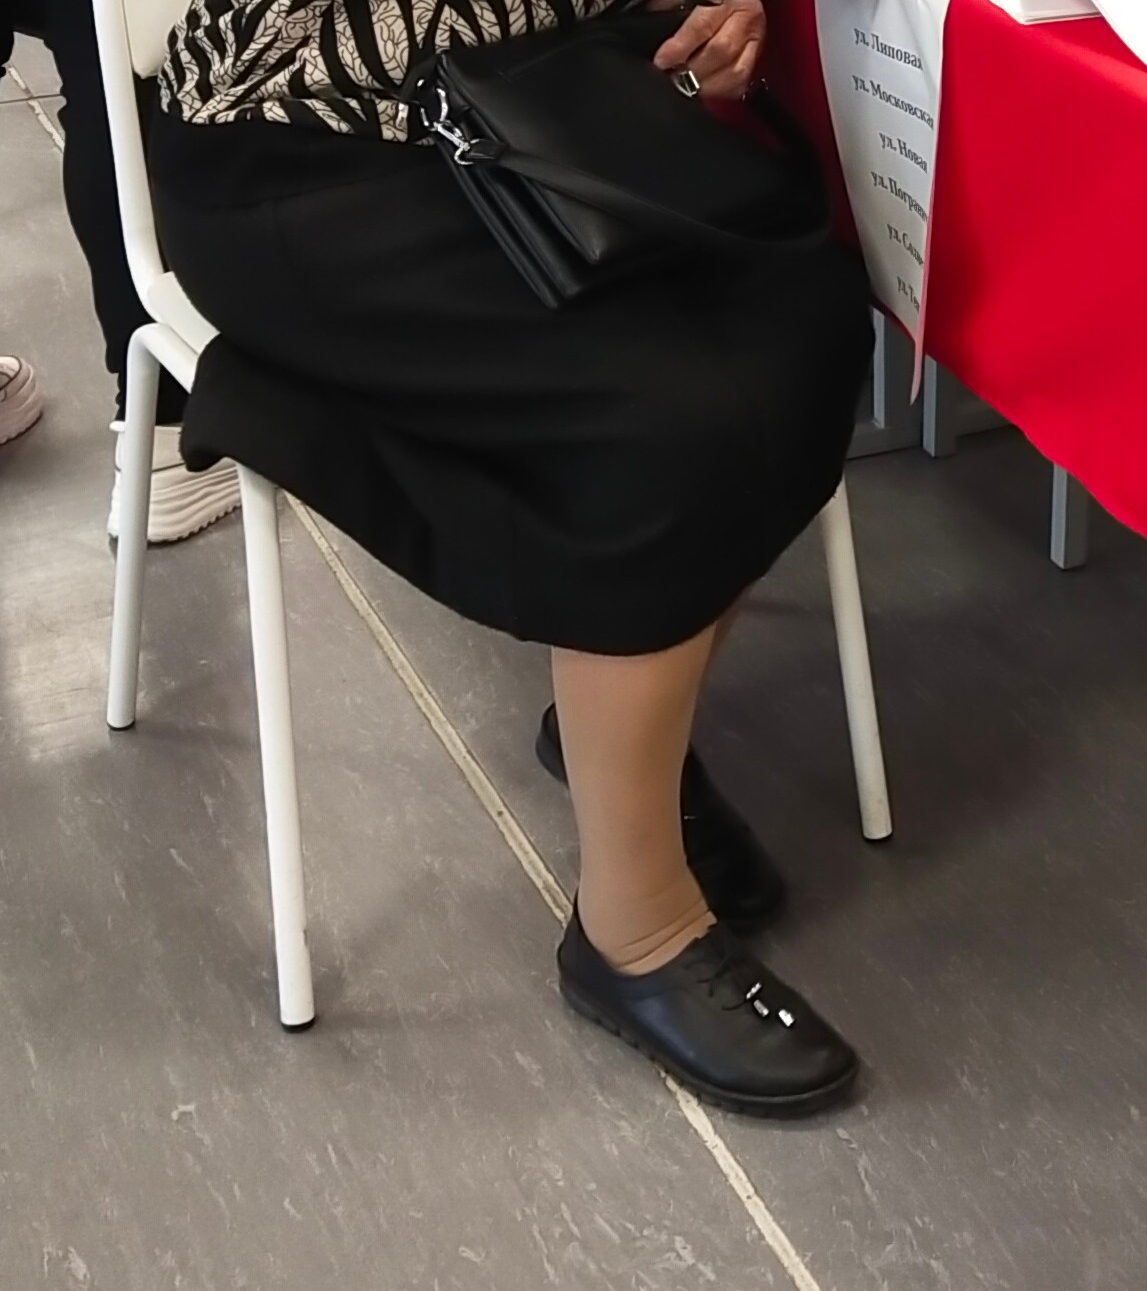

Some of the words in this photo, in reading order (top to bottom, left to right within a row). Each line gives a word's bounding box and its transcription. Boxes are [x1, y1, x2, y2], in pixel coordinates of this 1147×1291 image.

[854, 28, 869, 46] ул.
[852, 74, 869, 93] ул.
[879, 132, 897, 151] ул.
[871, 171, 888, 190] ул.
[887, 224, 901, 243] ул.
